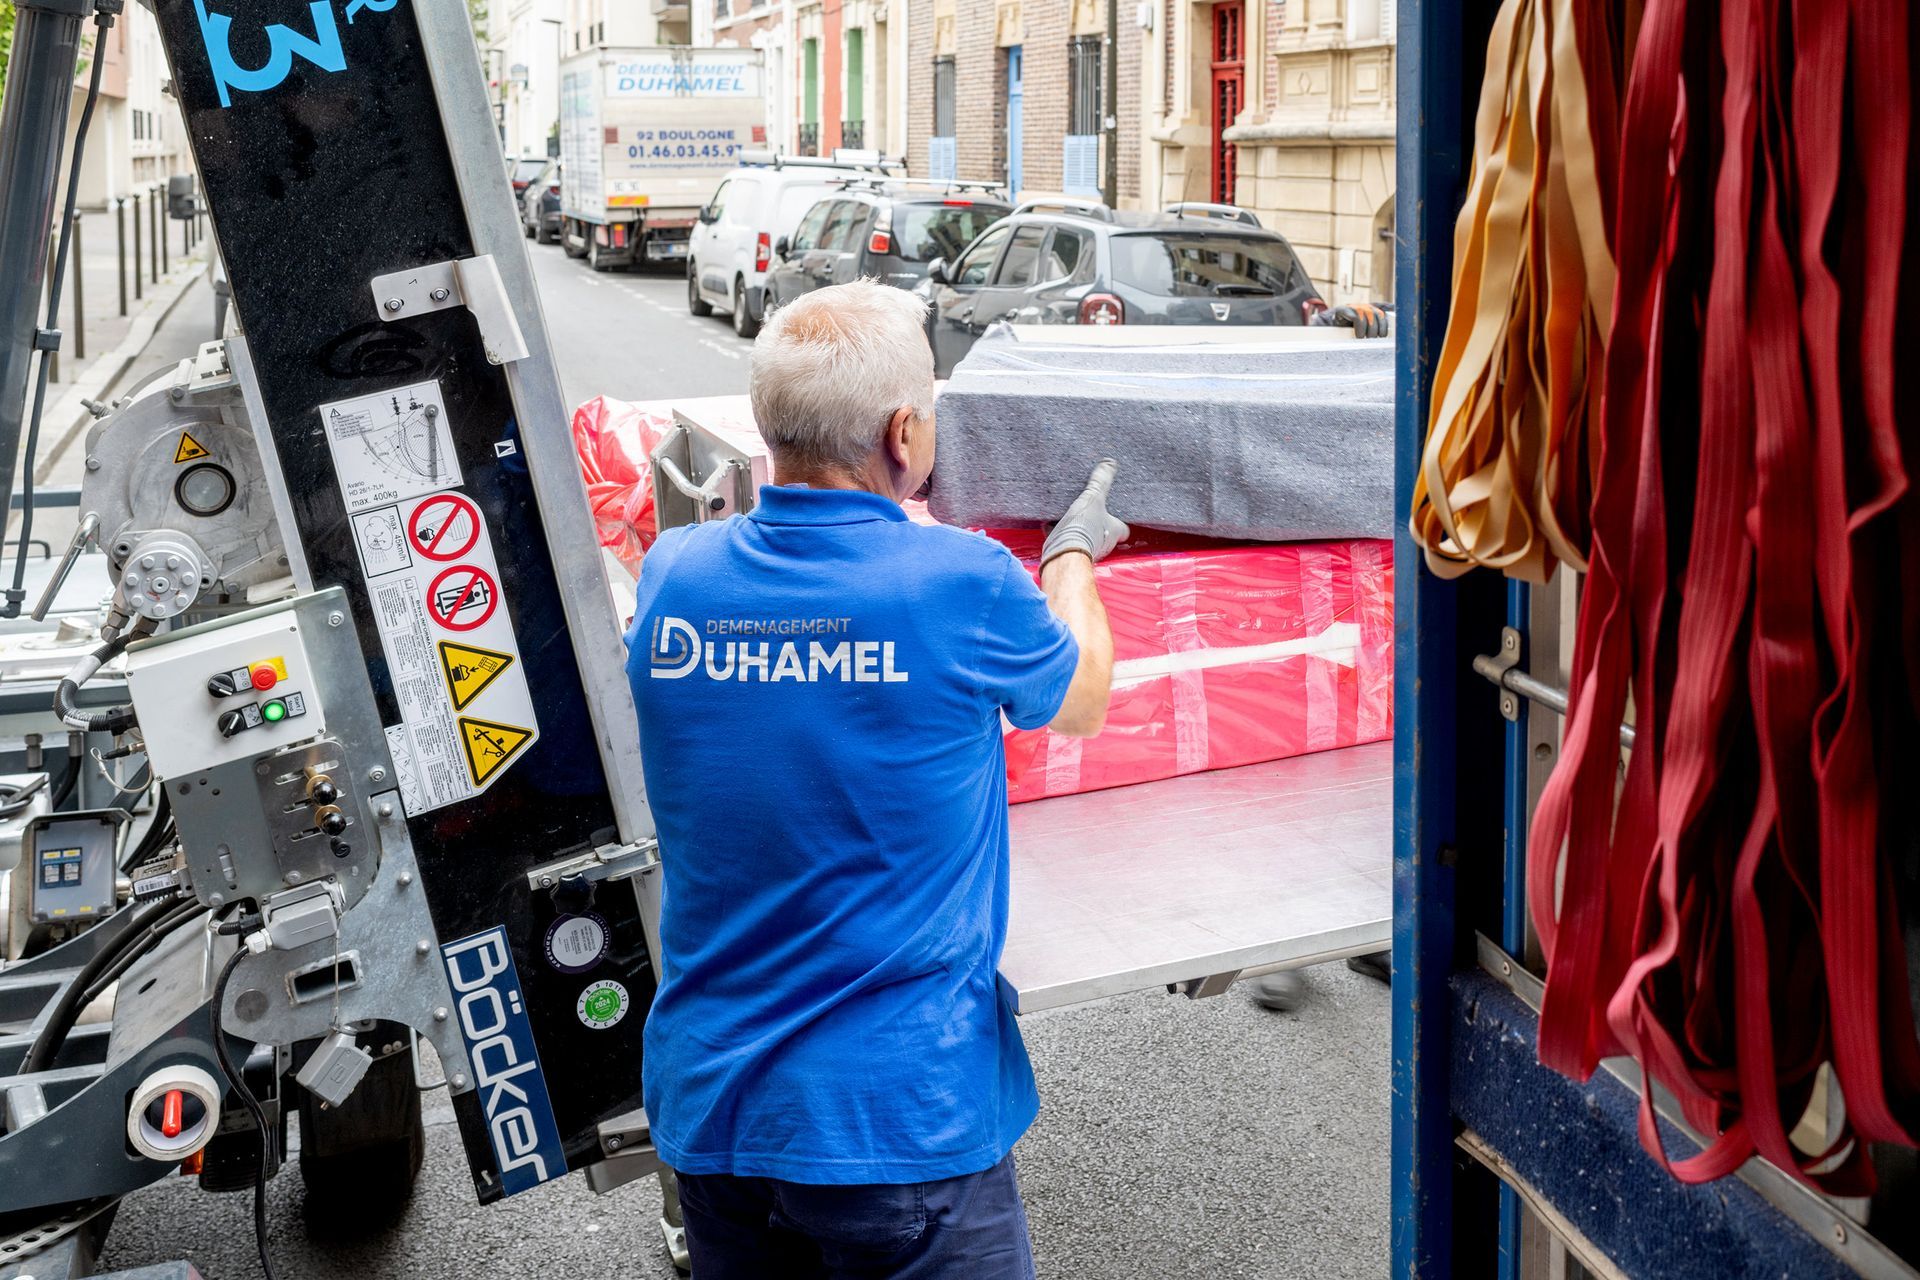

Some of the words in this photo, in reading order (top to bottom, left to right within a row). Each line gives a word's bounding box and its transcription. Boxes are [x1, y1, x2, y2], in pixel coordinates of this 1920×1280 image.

[618, 78, 746, 91] DUHAMEL
[637, 131, 654, 140] 92
[659, 130, 735, 140] BOULOGNE
[347, 480, 365, 489] Avario
[351, 498, 372, 507] max.
[373, 490, 398, 501] 400kg
[394, 535, 407, 562] 45km/h
[706, 617, 852, 635] DEMENAGEMENT
[420, 618, 436, 660] INFORMATION
[651, 616, 909, 683] DUHAMEL
